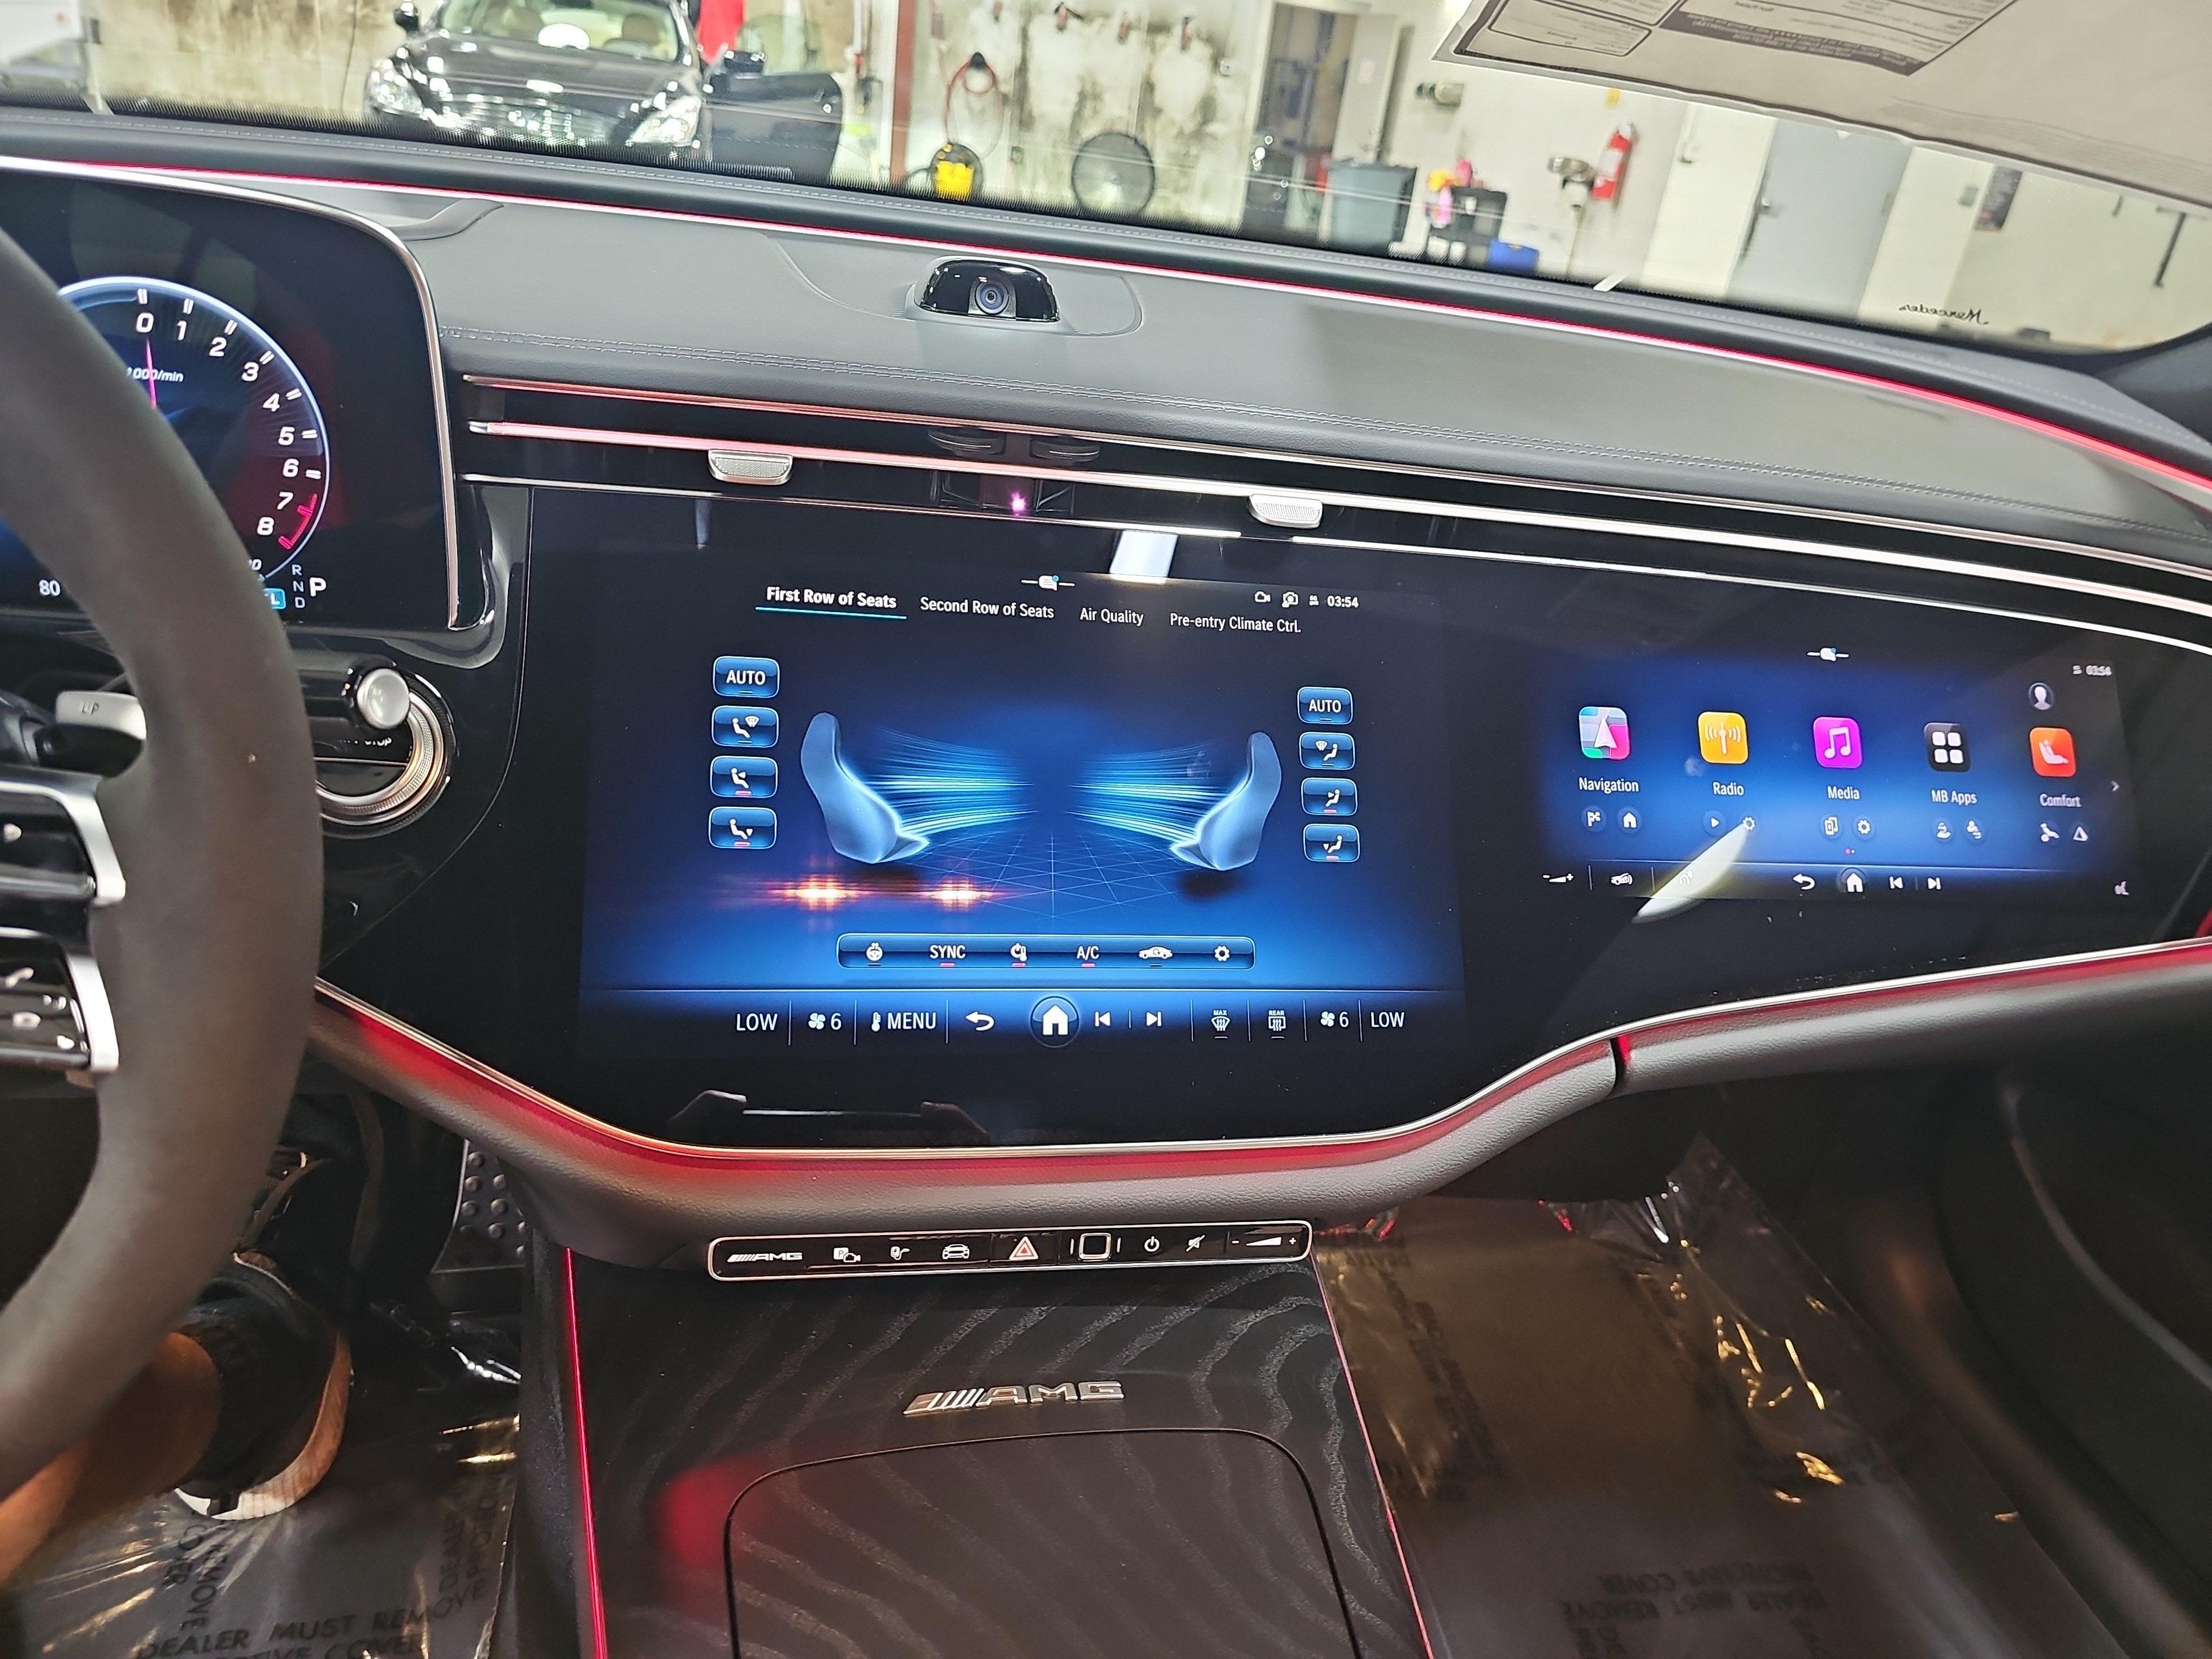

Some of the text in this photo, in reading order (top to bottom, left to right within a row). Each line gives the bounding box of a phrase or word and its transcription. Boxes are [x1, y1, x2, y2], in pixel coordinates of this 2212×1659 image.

[136, 313, 154, 332] 0
[177, 320, 187, 340] 1
[209, 337, 227, 357] 2
[242, 362, 259, 381] 3
[263, 394, 280, 411] 4
[278, 427, 294, 446] 5
[283, 459, 298, 477] 6
[277, 492, 293, 510] 7
[257, 517, 274, 536] 8
[292, 564, 302, 576] R
[39, 580, 61, 596] 80
[293, 581, 304, 592] N
[310, 577, 326, 596] P
[295, 597, 305, 608] D
[767, 587, 897, 608] First Row of Seats
[1327, 595, 1359, 607] 03:54
[920, 597, 1054, 618] Second Row of Seats
[1079, 608, 1144, 625] Air Quality
[1170, 613, 1301, 633] Pre-entry Climate Ctrl.
[726, 671, 766, 685] AUTO
[1309, 699, 1341, 712] AUTO
[1579, 777, 1639, 794] Navigation
[1713, 782, 1744, 796] Radio
[1828, 786, 1860, 800] Media
[1932, 790, 1977, 805] MB Apps
[2040, 794, 2081, 807] Comfort
[929, 944, 966, 959] SYNC
[1076, 946, 1099, 960] A/C
[736, 1013, 778, 1031] LOW
[831, 1013, 842, 1030] 6
[888, 1012, 936, 1030] MENU
[1339, 1012, 1349, 1027] 6
[1371, 1012, 1405, 1027] LOW
[269, 1615, 356, 1641] MUST
